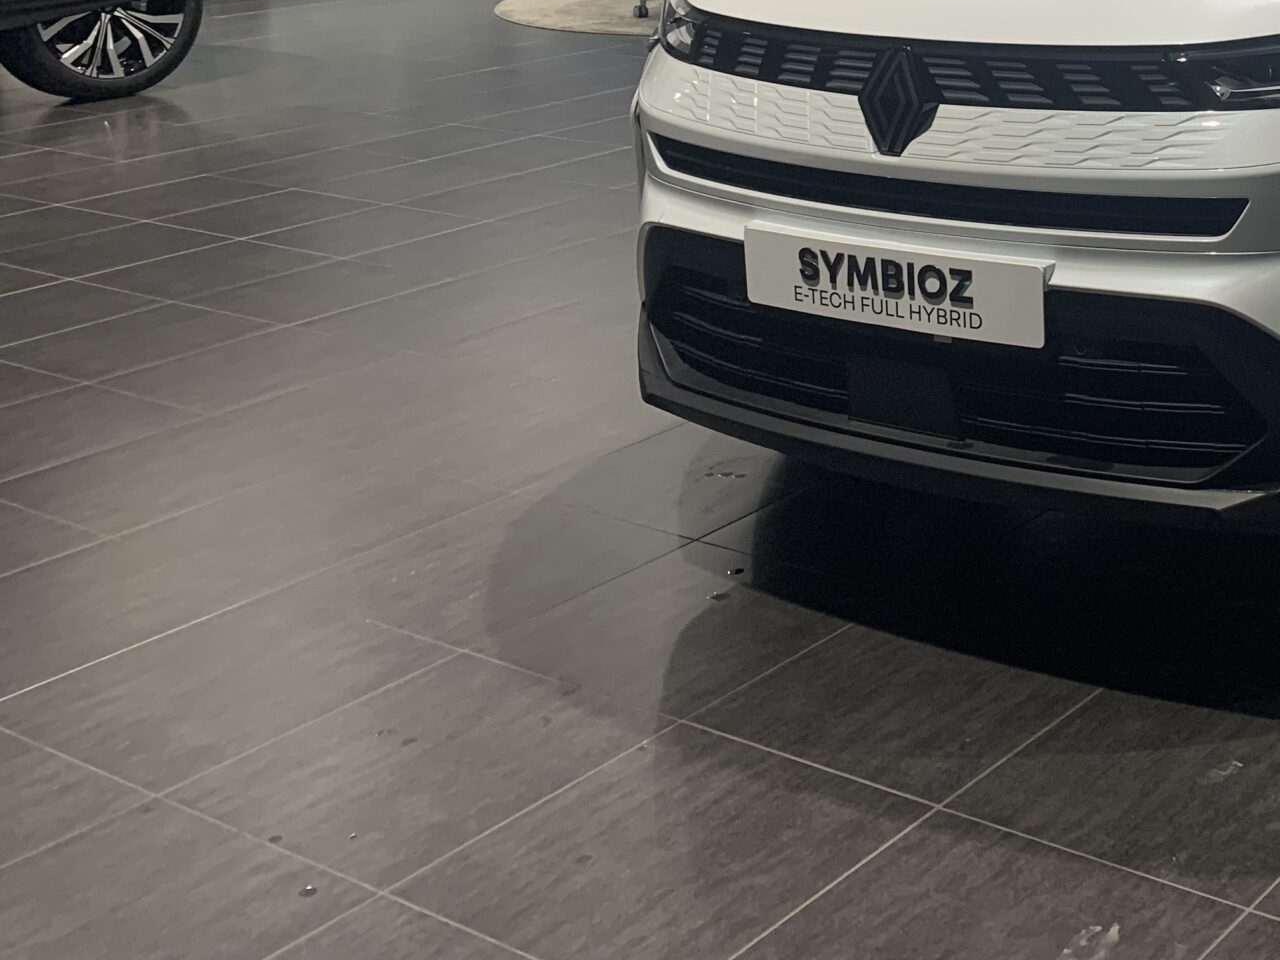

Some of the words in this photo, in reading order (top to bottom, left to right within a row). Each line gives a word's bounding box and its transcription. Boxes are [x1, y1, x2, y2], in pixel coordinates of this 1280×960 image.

[798, 247, 974, 306] SYMBIOZ
[794, 285, 856, 312] E-TECH
[861, 296, 905, 319] FULL
[909, 306, 983, 330] HYBRID
